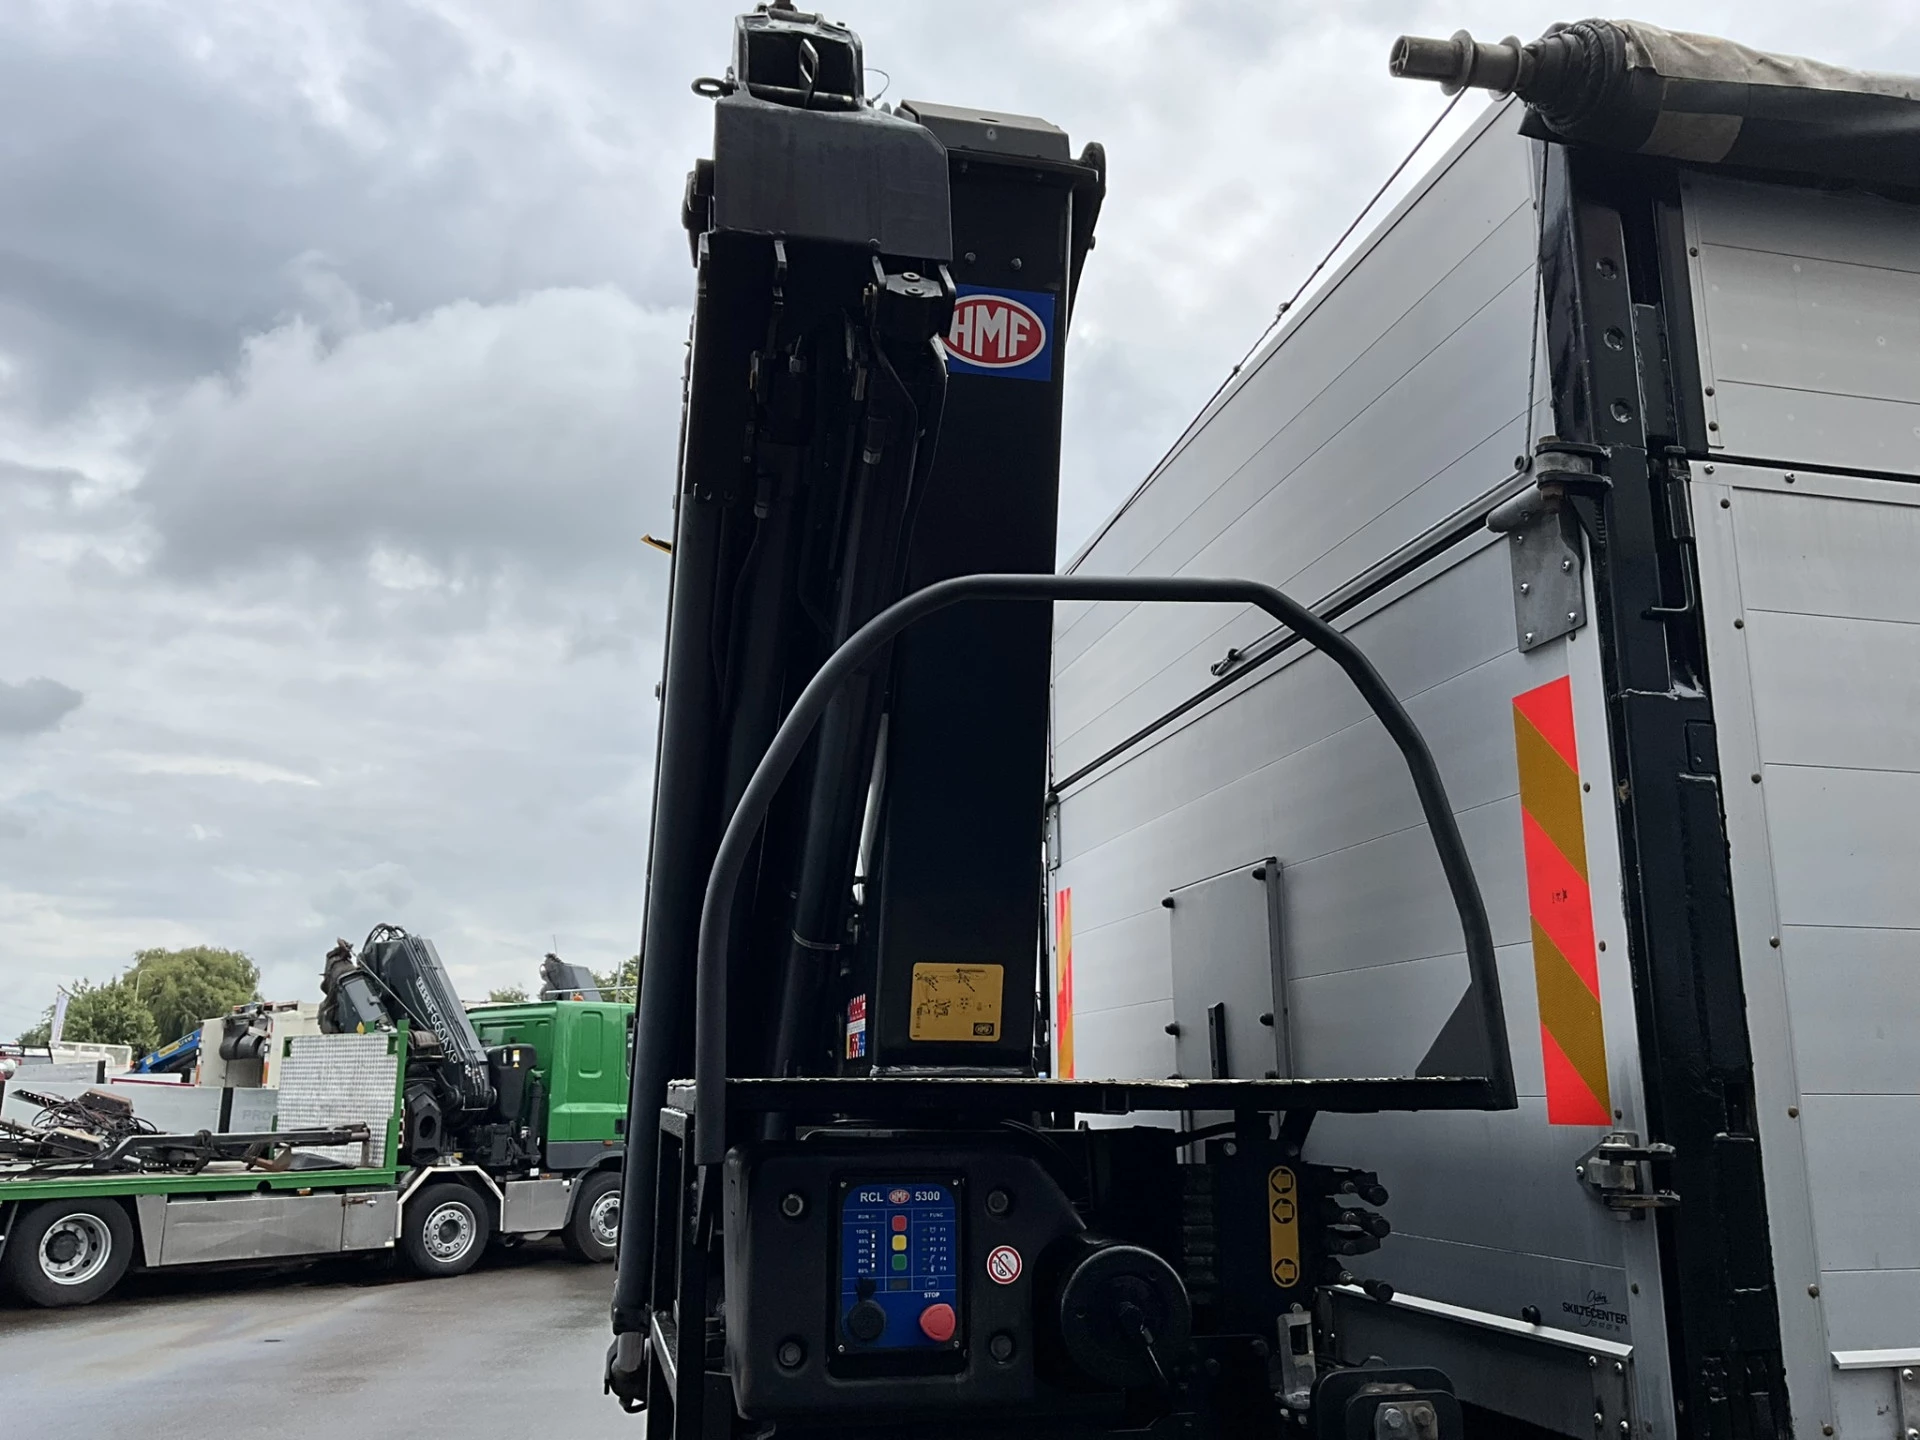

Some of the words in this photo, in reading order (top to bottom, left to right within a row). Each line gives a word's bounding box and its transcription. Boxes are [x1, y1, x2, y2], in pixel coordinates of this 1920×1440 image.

[948, 304, 1031, 359] HMF
[860, 1192, 884, 1203] RCL
[915, 1191, 940, 1201] 5300
[1562, 1302, 1628, 1325] SKILTECENTER
